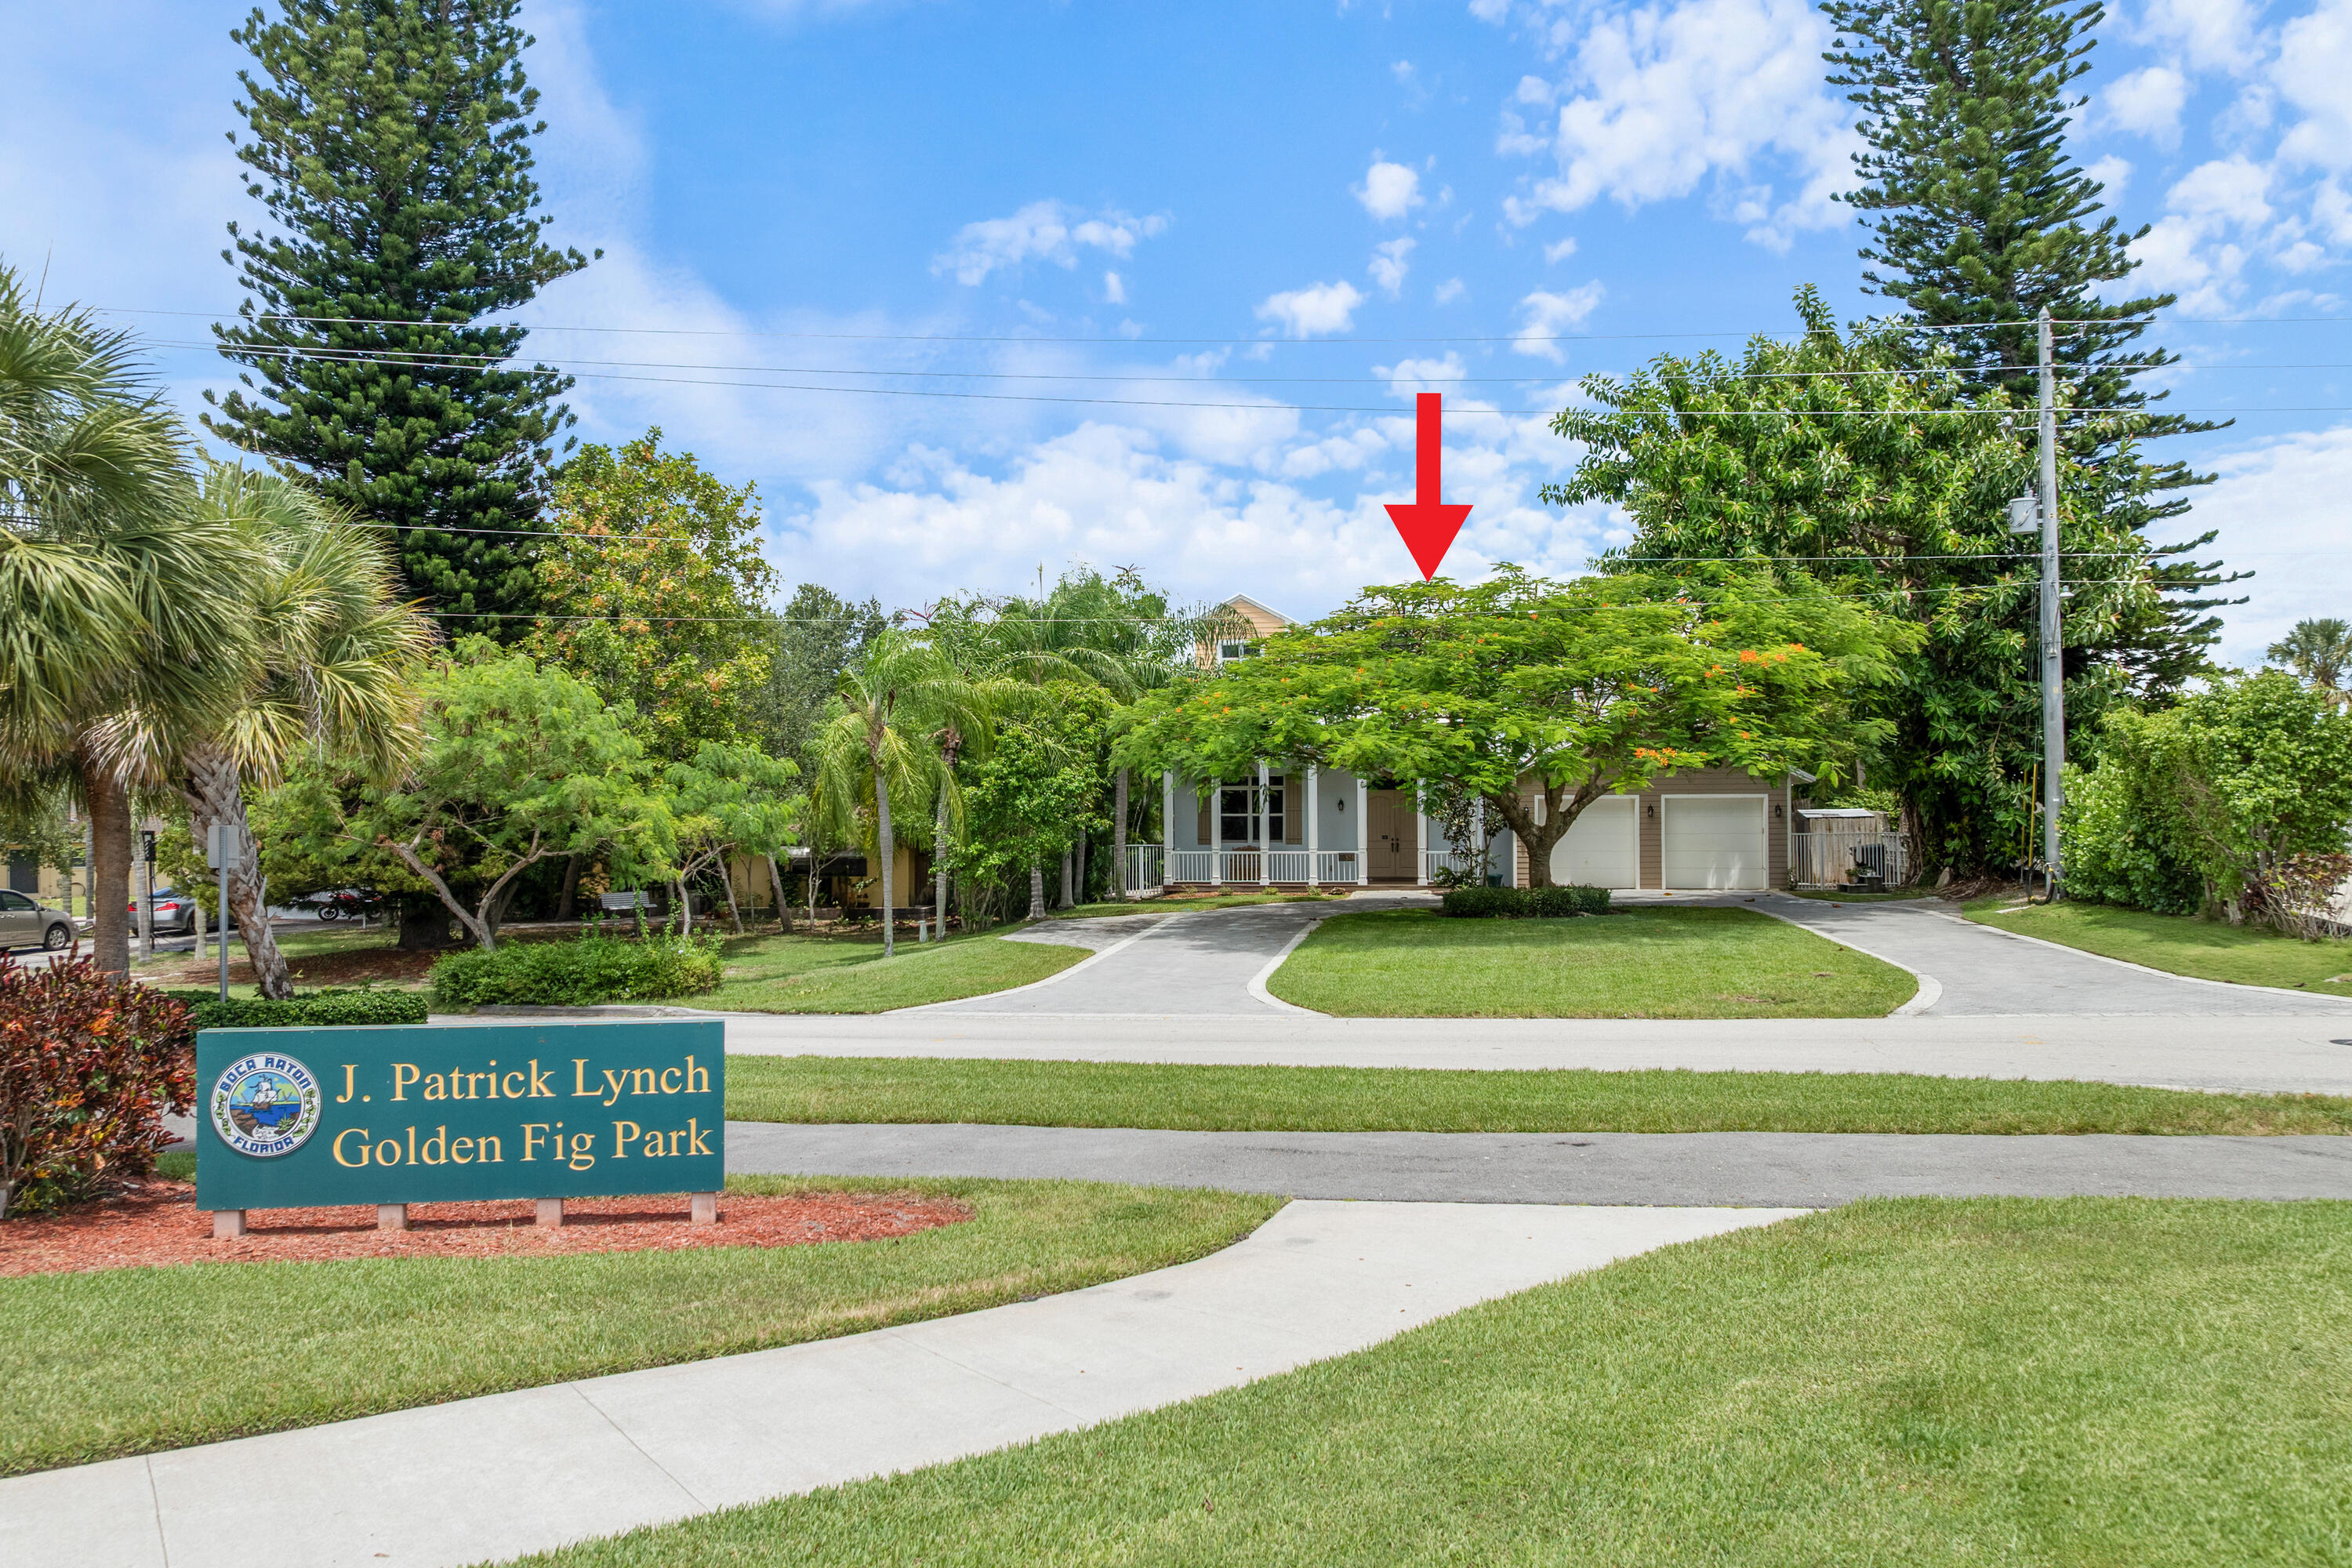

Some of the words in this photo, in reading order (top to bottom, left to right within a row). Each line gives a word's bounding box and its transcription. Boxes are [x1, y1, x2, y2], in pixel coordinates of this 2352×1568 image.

[220, 1059, 256, 1091] BOCA
[265, 1058, 312, 1089] RATON
[336, 1064, 371, 1103] J.
[391, 1059, 555, 1102] Patrick
[572, 1054, 711, 1107] Lynch
[234, 1137, 294, 1152] FLORIDA
[332, 1124, 503, 1167] Golden
[521, 1120, 596, 1171] Fig
[612, 1117, 713, 1158] Park
